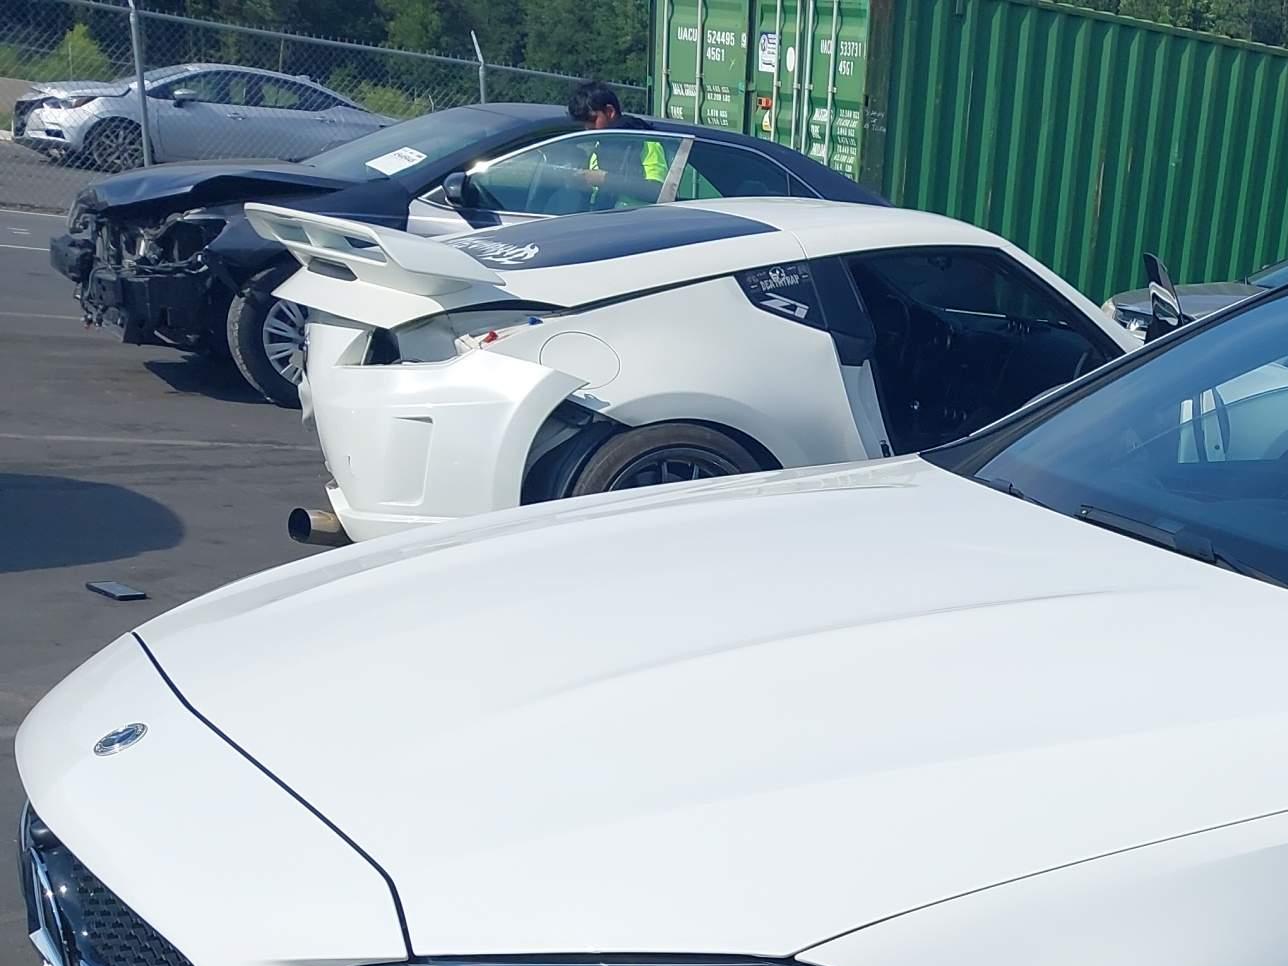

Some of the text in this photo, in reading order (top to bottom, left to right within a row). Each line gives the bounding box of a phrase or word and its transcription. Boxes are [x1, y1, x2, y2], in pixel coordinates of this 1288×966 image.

[677, 26, 747, 49] UACU 524495 9
[706, 46, 725, 62] 45G1
[820, 39, 862, 57] UAC 533731
